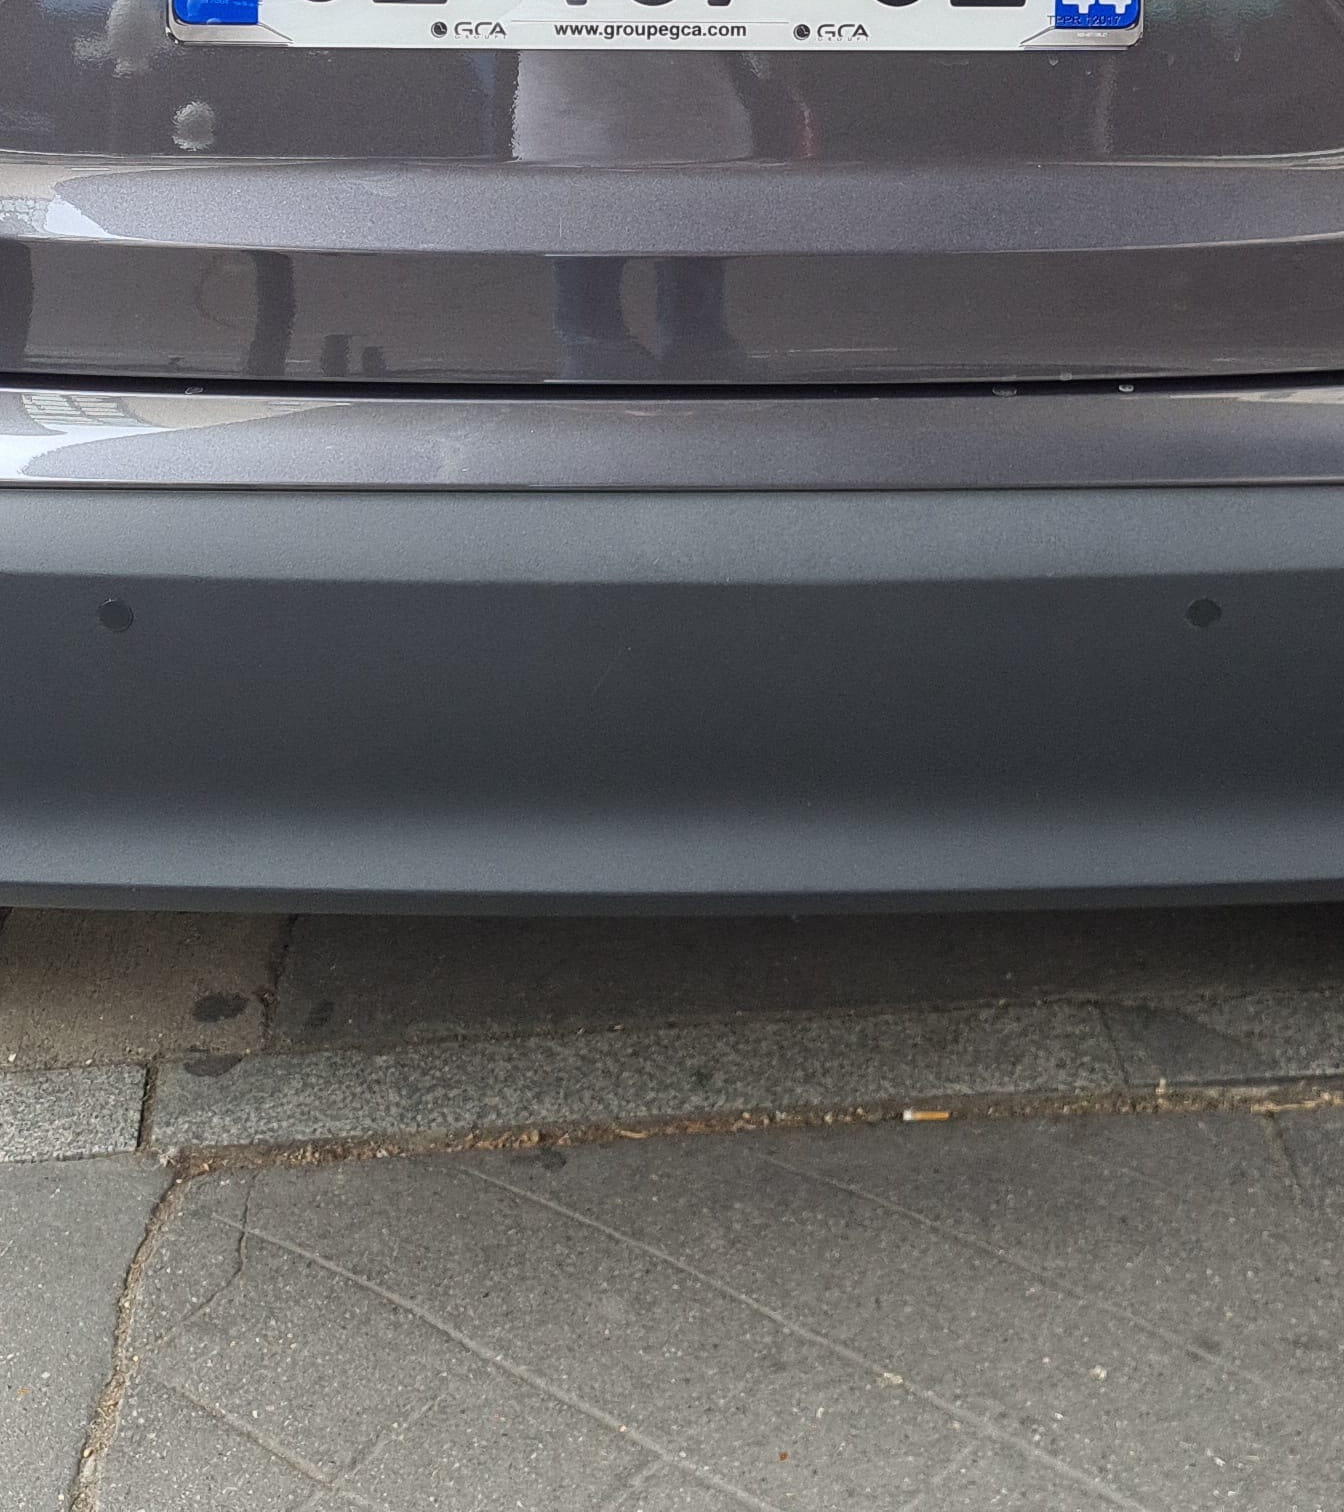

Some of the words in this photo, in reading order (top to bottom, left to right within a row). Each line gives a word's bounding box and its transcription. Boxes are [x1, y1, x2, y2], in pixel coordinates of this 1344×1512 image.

[454, 21, 506, 35] GCA
[554, 24, 746, 40] www.groupegca.com
[817, 23, 869, 37] GCA
